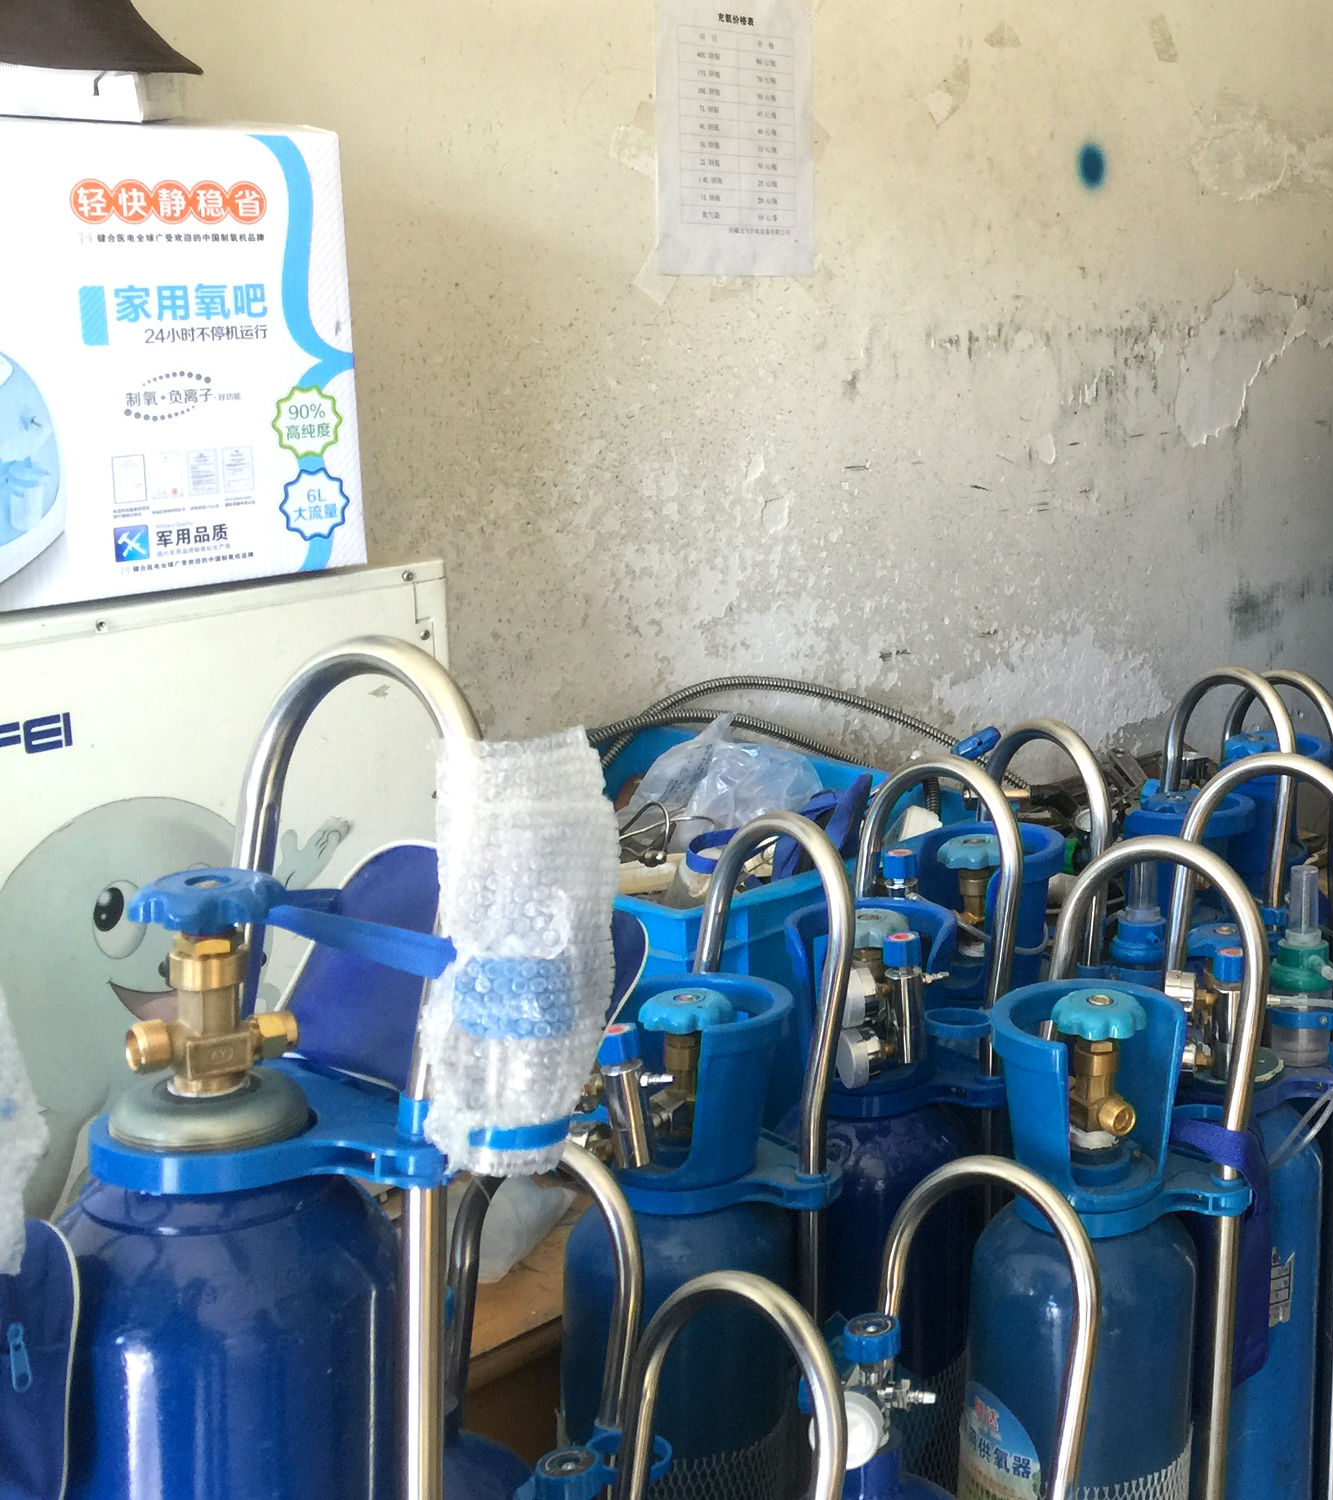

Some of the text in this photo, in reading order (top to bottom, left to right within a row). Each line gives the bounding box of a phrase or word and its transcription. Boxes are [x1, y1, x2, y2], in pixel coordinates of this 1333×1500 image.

[76, 186, 261, 218] 轻快静稳省
[114, 283, 268, 323] 家用氧吧
[144, 324, 268, 344] 24小时不停机运行
[288, 402, 326, 420] 90%
[286, 422, 331, 440] 高纯度
[306, 488, 328, 503] 6L
[293, 503, 338, 522] 大流量
[156, 523, 228, 547] 军用品质
